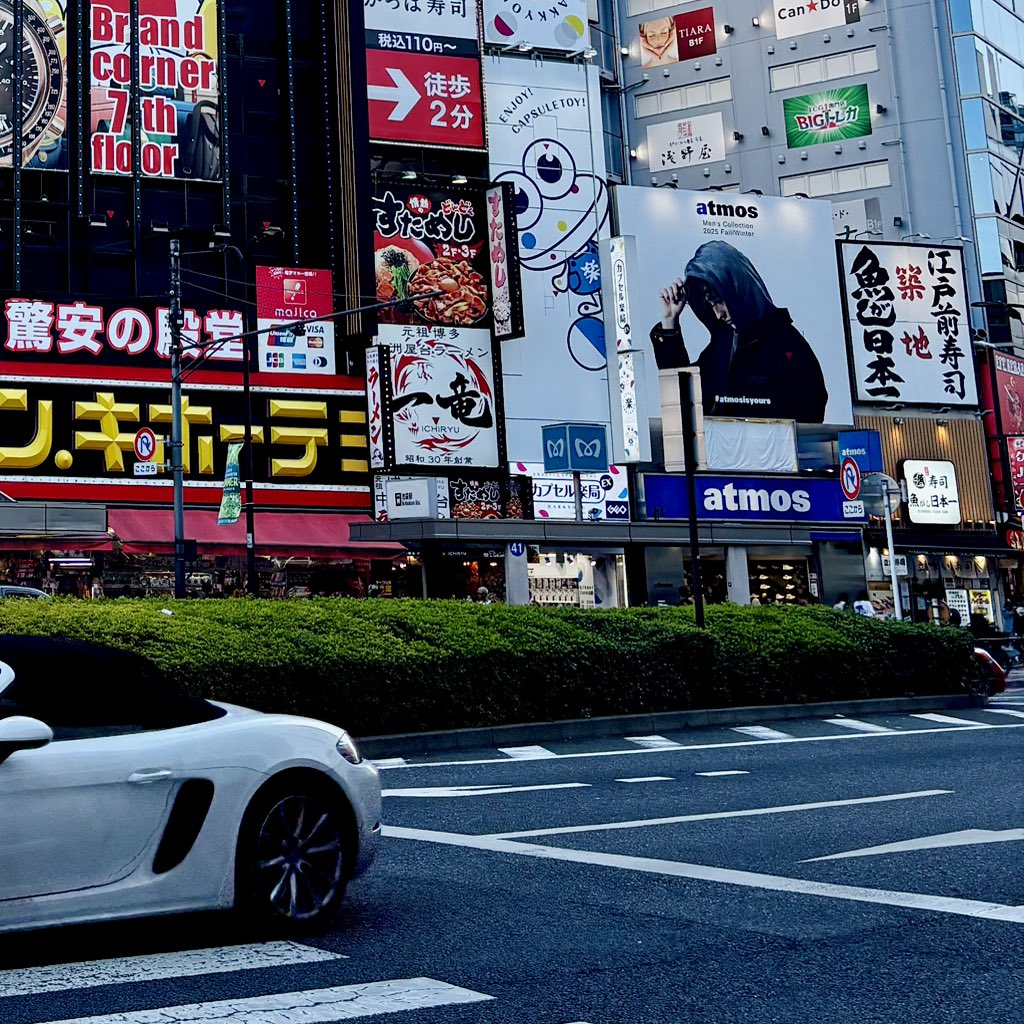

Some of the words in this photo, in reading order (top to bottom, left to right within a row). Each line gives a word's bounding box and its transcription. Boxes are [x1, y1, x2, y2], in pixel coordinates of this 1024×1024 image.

[846, 3, 858, 15] 1F
[93, 7, 203, 50] Brand
[679, 23, 712, 38] TIARA
[688, 36, 704, 47] B1F
[424, 72, 471, 99] 徒歩
[499, 87, 534, 123] ENJOY!
[430, 101, 473, 129] 2分
[92, 136, 178, 176] floor
[696, 201, 759, 219] atmos
[702, 220, 721, 228] Men's
[721, 229, 755, 237] Fall/Winter
[275, 308, 317, 319] majica
[895, 263, 933, 360] 築地
[5, 299, 246, 361] 驚安の殿堂
[306, 325, 325, 334] VISA
[927, 250, 966, 400] 江戸前寿司
[402, 326, 460, 339] 元祖博多
[379, 341, 490, 358] 洲屋台ラーメン
[367, 366, 382, 445] ラーメン
[422, 426, 460, 434] ICHIRYU
[842, 447, 866, 456] atmos
[134, 463, 157, 473] ここから
[928, 475, 949, 489] 寿司
[704, 483, 812, 513] atmos
[607, 504, 627, 515] GEO
[844, 502, 863, 516] ここから
[510, 542, 523, 554] 41
